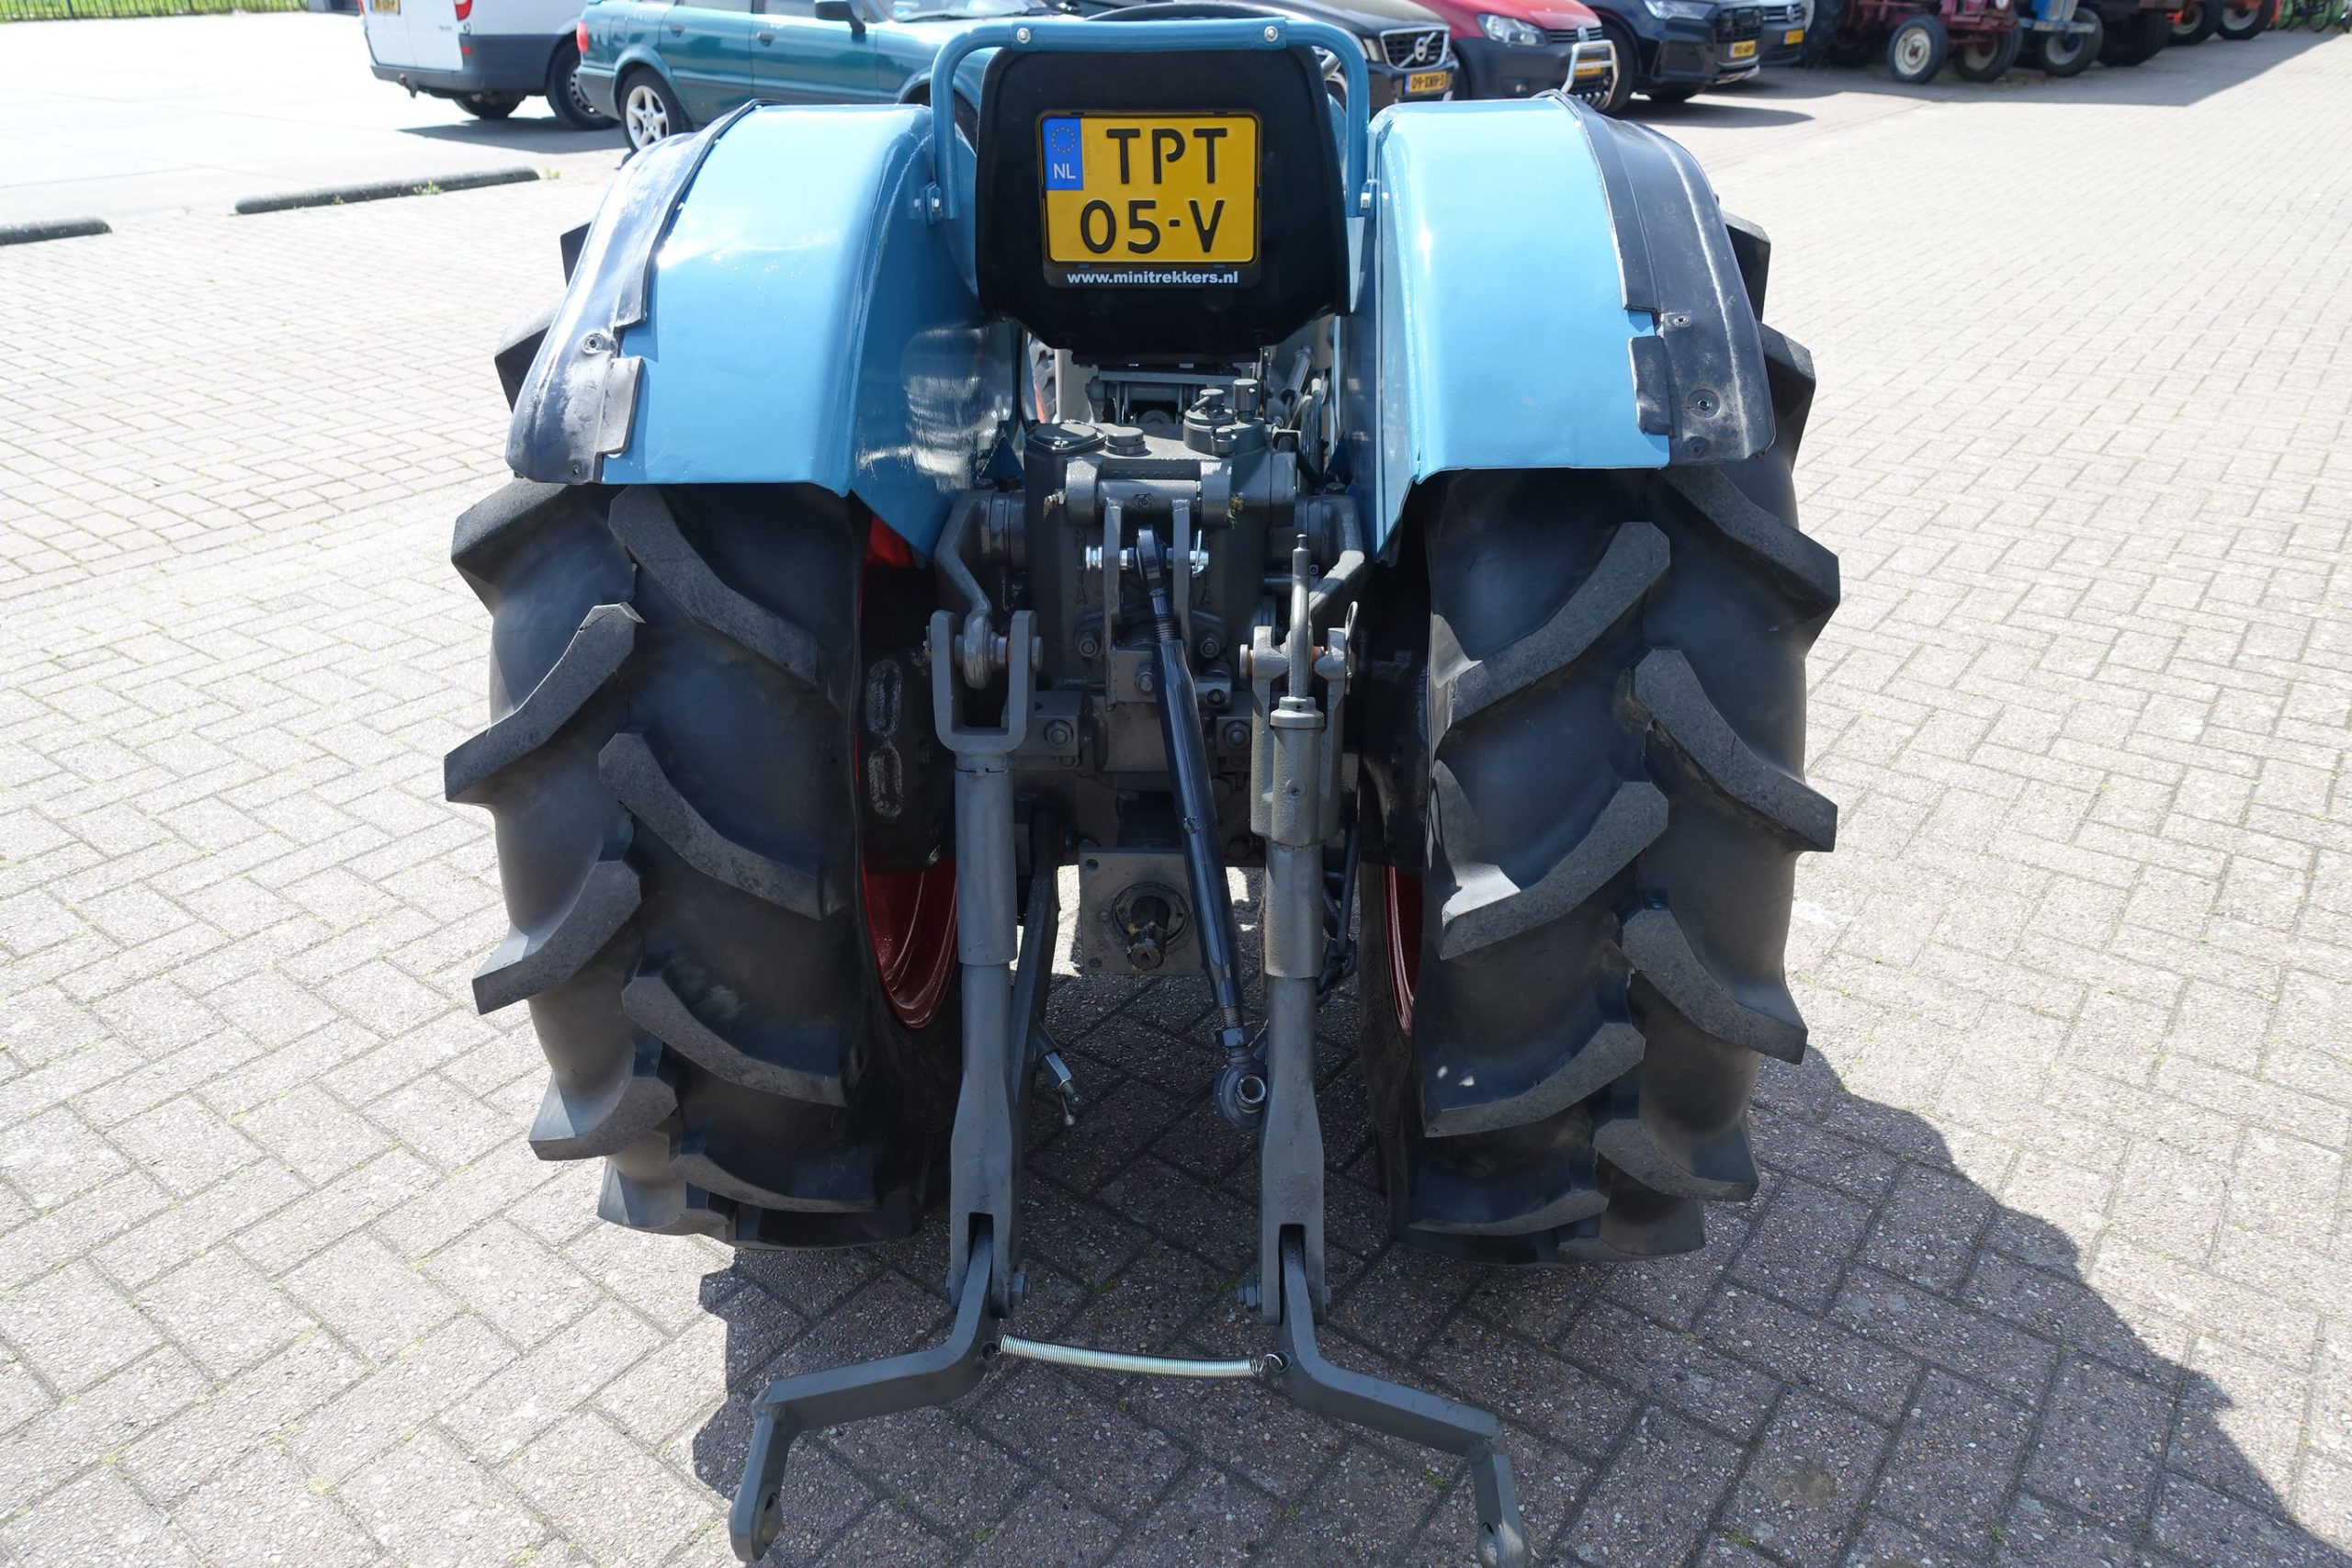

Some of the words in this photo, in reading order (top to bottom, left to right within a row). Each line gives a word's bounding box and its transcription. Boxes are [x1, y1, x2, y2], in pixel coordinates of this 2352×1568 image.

[1053, 163, 1076, 180] NL
[1106, 128, 1227, 185] TPT
[1080, 199, 1225, 254] 05-V
[1067, 271, 1238, 284] www.minitrekkers.nl
